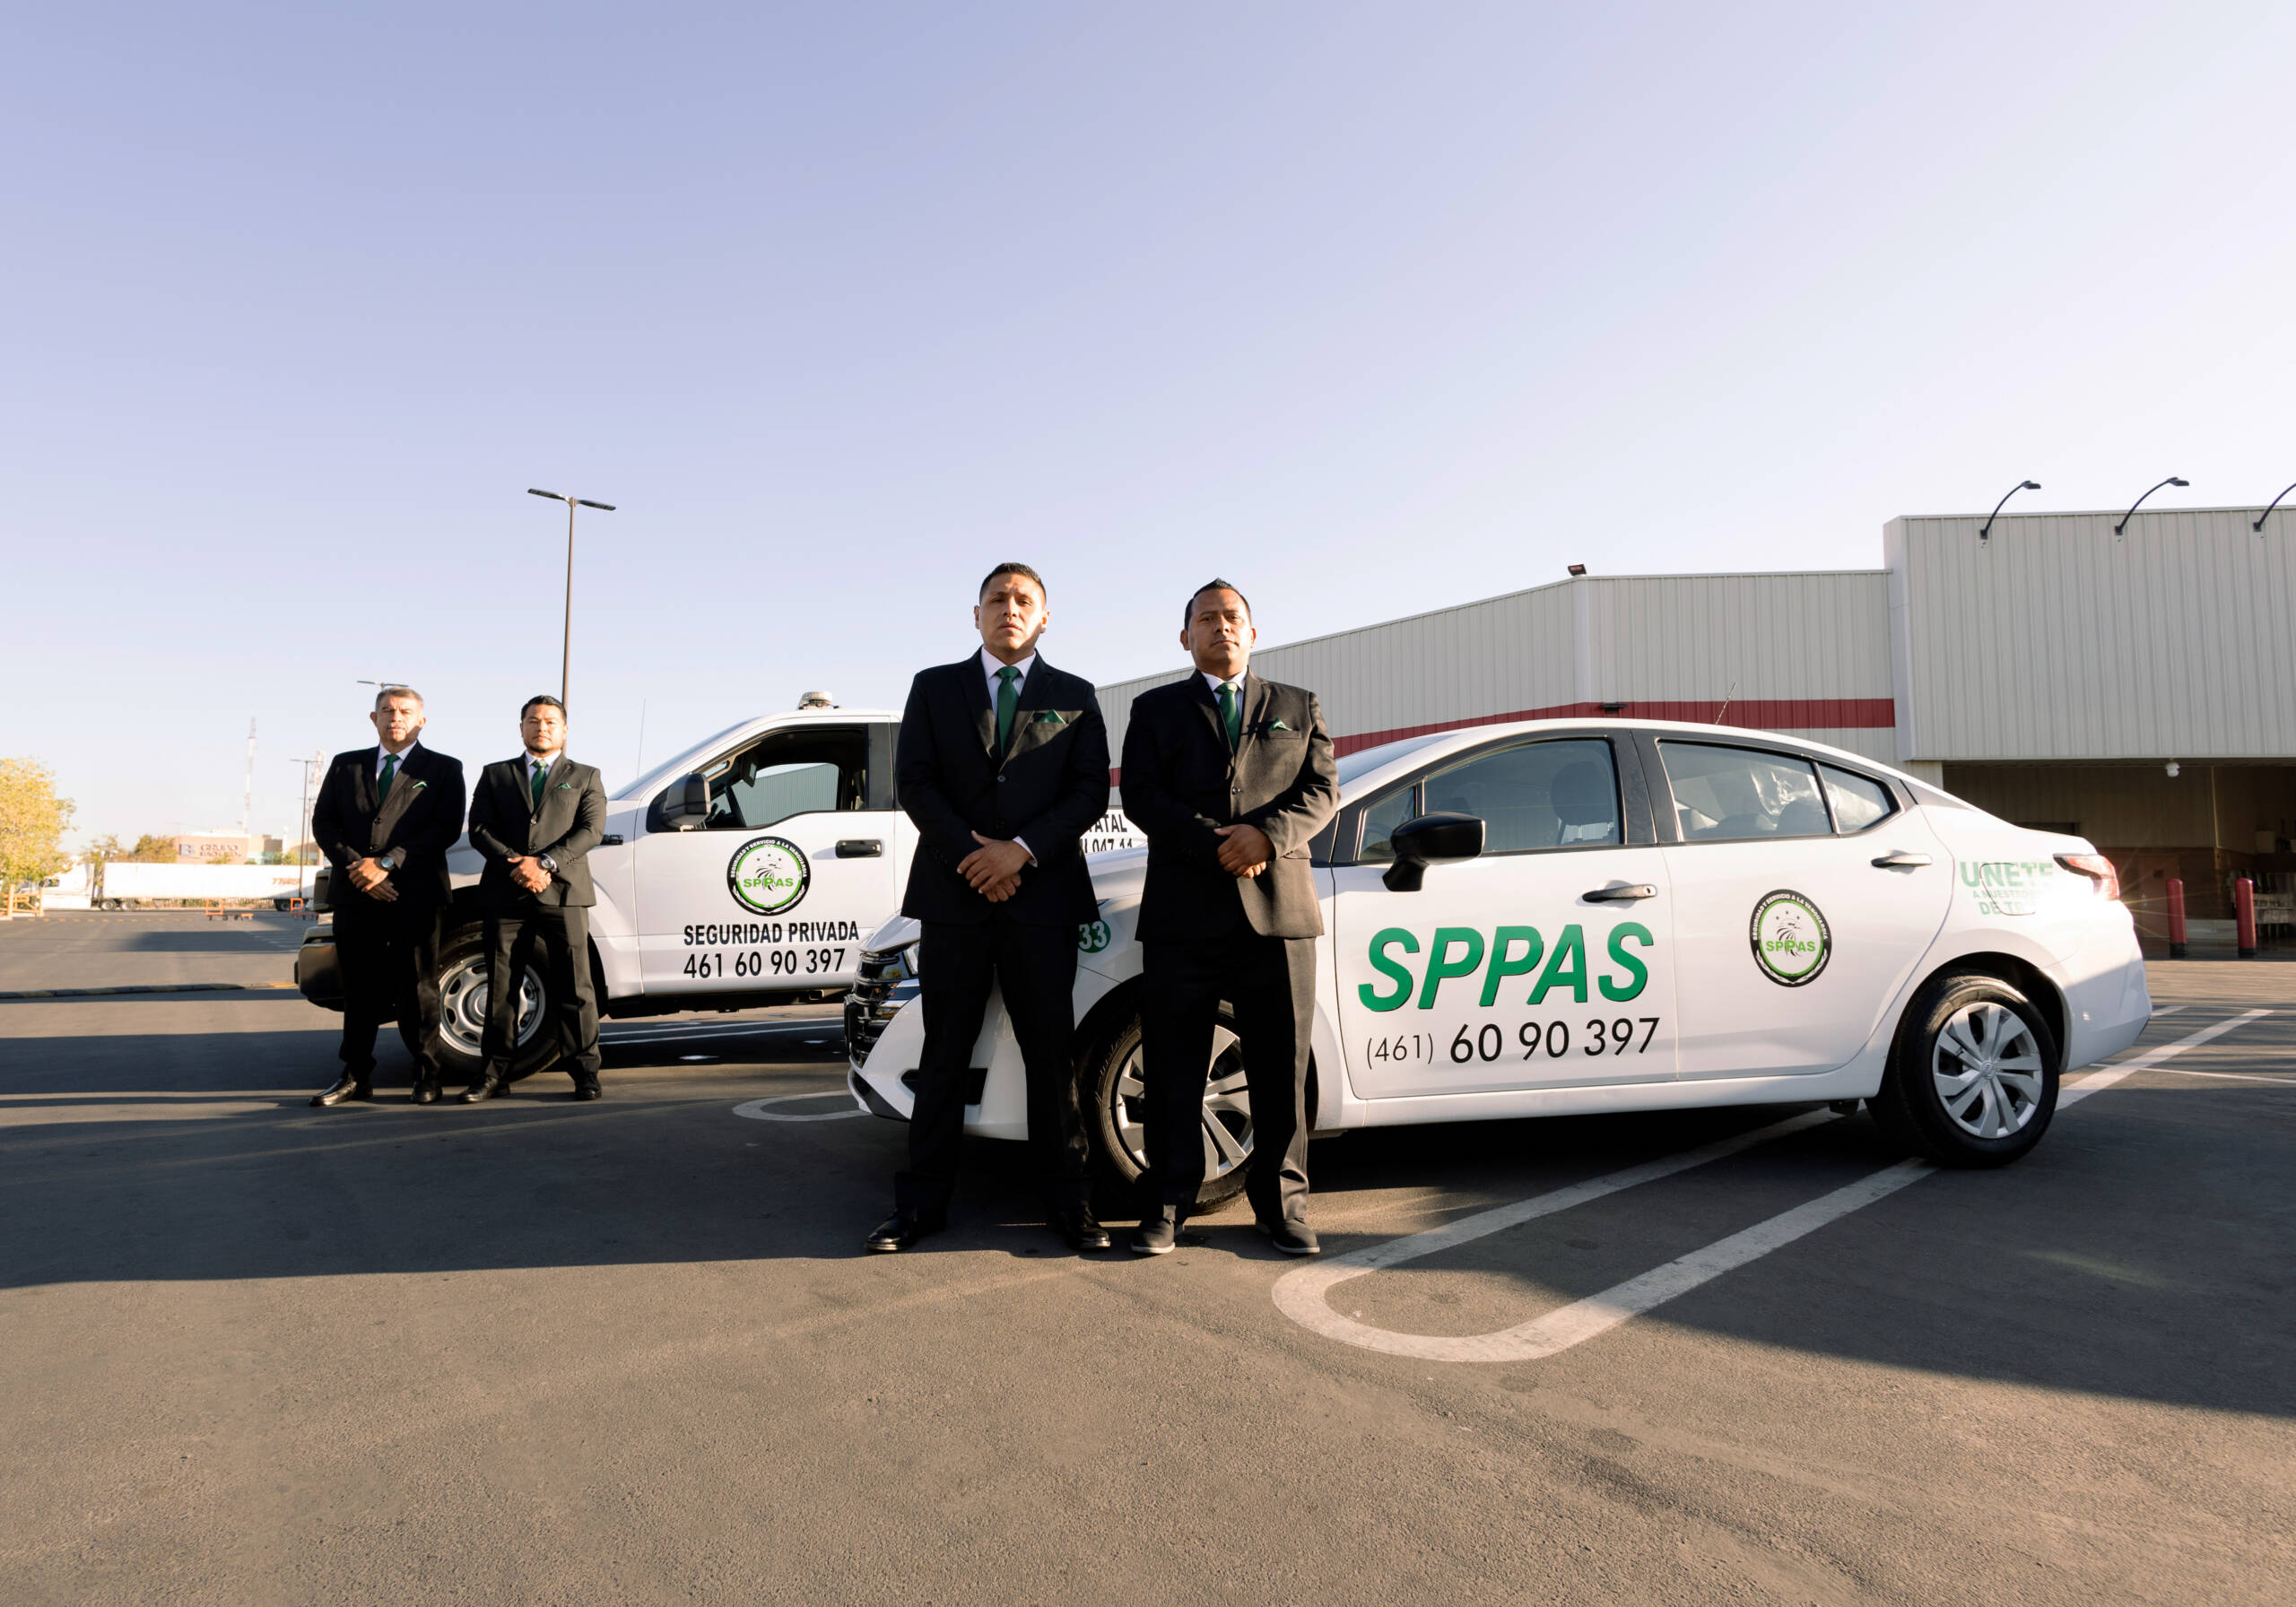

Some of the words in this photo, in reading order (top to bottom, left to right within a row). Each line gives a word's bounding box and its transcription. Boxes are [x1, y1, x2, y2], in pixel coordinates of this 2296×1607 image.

[1089, 813, 1127, 833] ATAL
[743, 877, 794, 888] SPPAS
[683, 923, 783, 946] SEGURIDAD
[788, 920, 860, 942] PRIVADA
[1765, 940, 1816, 952] SPPAS
[683, 952, 722, 978] 461
[735, 951, 761, 977] 60
[770, 950, 797, 975] 90
[805, 948, 846, 974] 397
[1358, 921, 1654, 1012] SPPAS
[1367, 1033, 1434, 1070] (461)
[1450, 1023, 1502, 1064] 60
[1518, 1021, 1570, 1061] 90
[1584, 1017, 1660, 1056] 397
